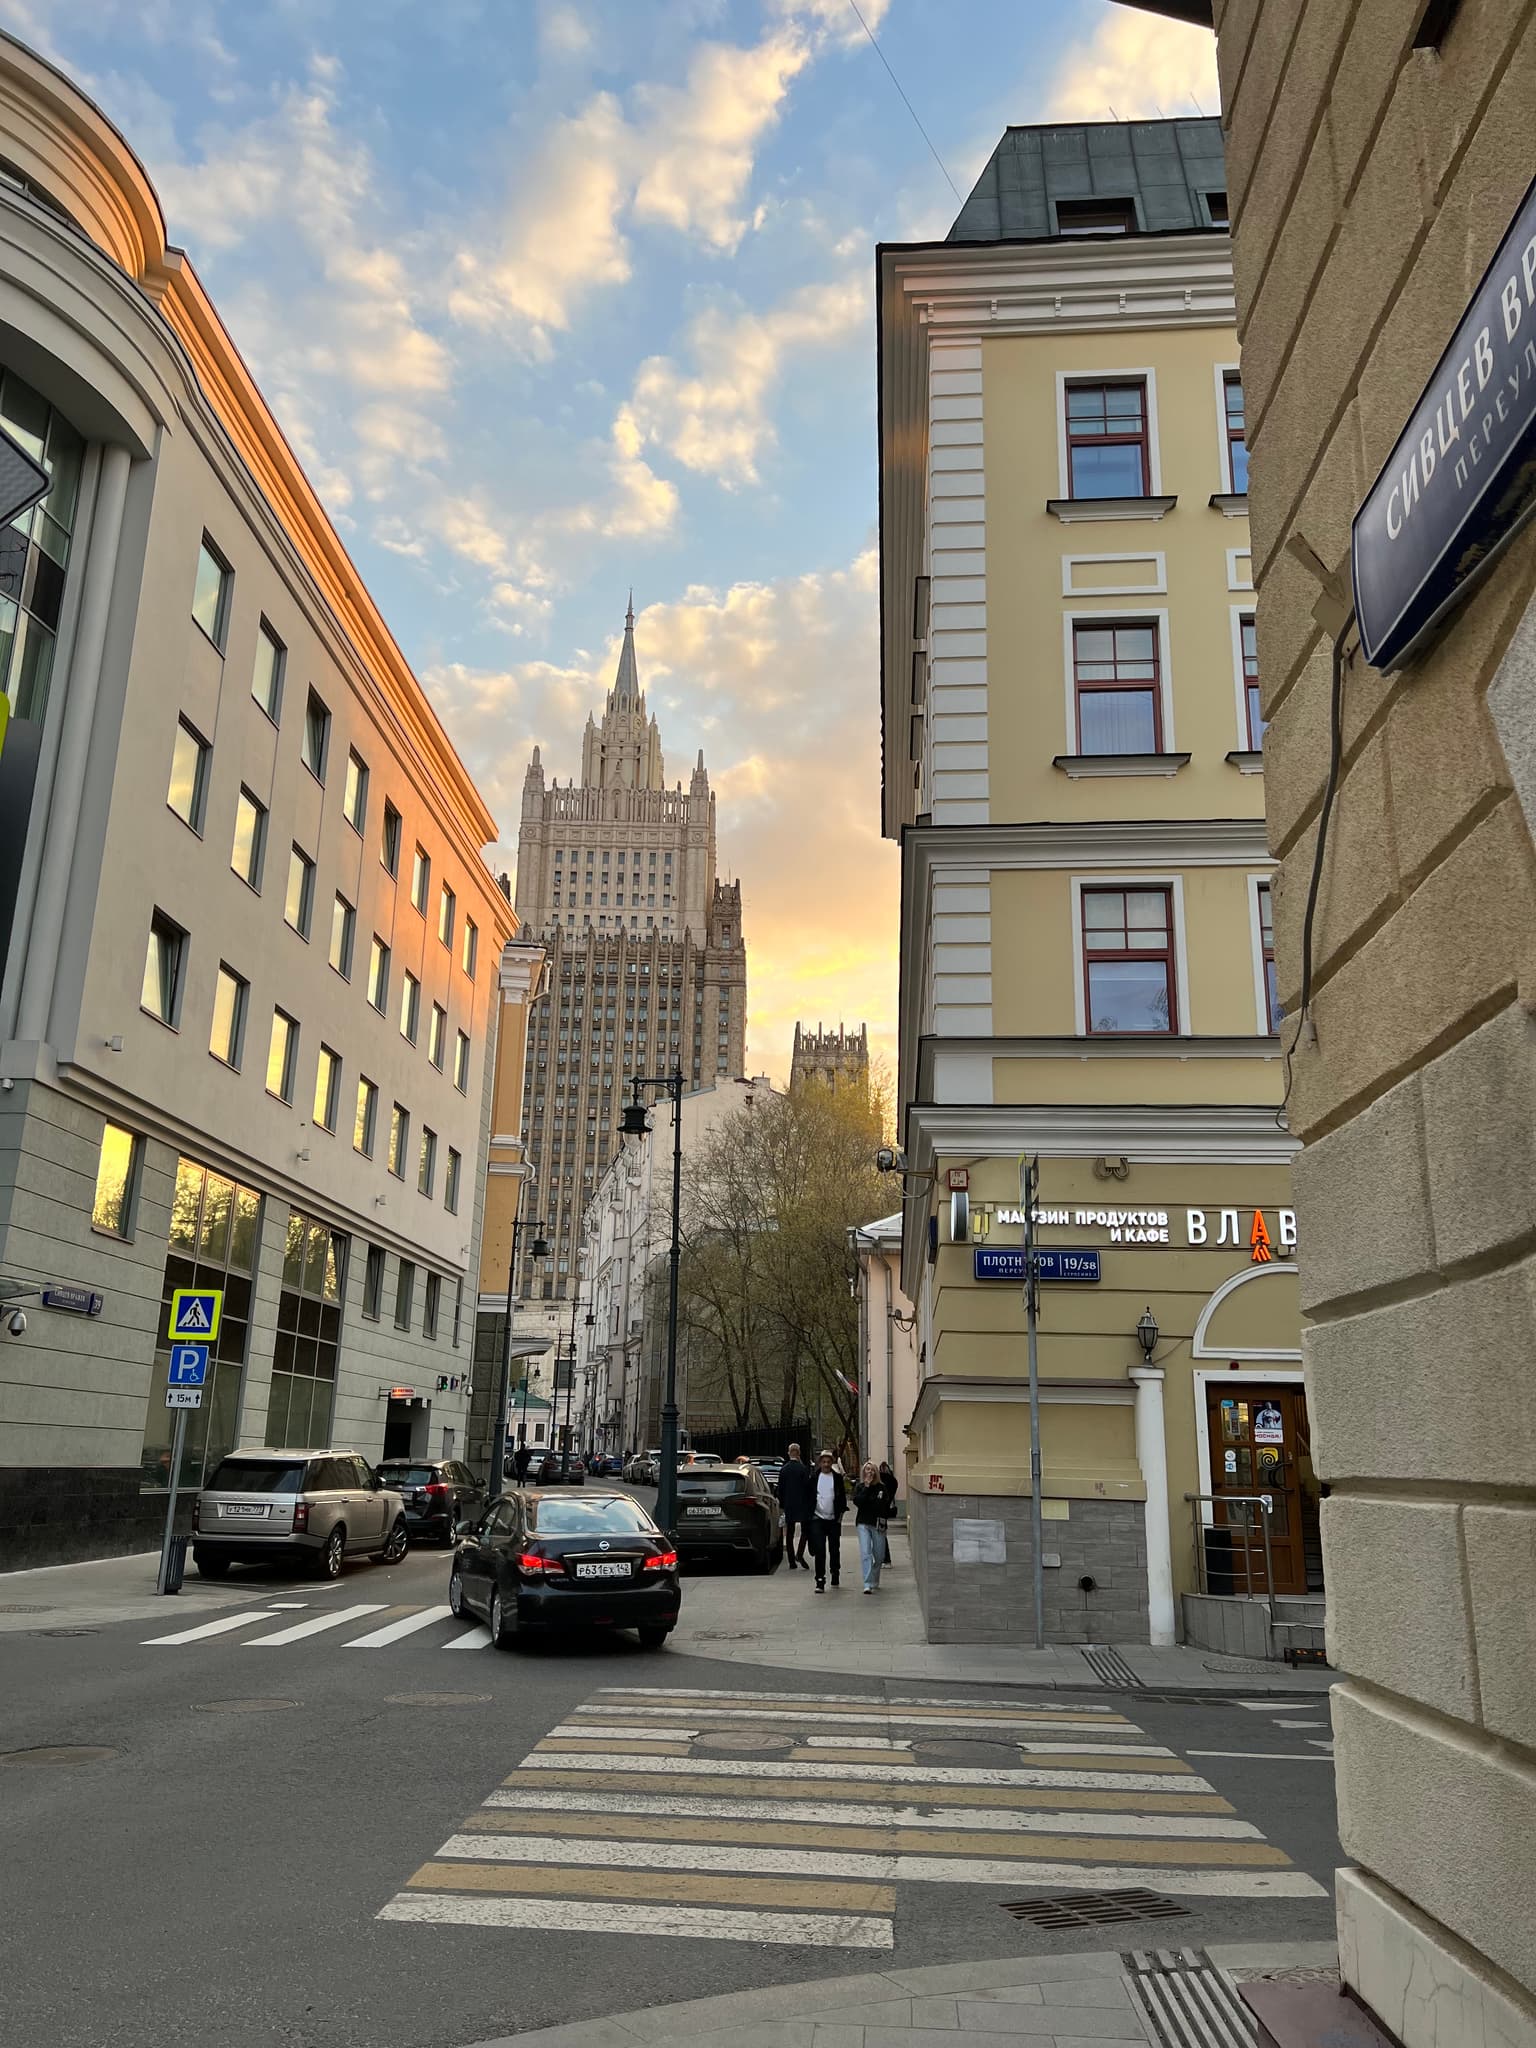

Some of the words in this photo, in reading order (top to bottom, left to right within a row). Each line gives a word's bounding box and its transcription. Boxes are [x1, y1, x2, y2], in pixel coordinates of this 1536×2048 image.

[1386, 324, 1495, 542] СИВЦЕВ
[1075, 1211, 1168, 1227] ПРОДУКТОВ
[1186, 1209, 1297, 1246] ВЛАВ
[1110, 1229, 1121, 1242] И
[1125, 1229, 1169, 1243] КАФЕ
[983, 1256, 1054, 1267] ПЛОТНКОВ
[1064, 1257, 1097, 1271] 19/38
[177, 1349, 200, 1380] P
